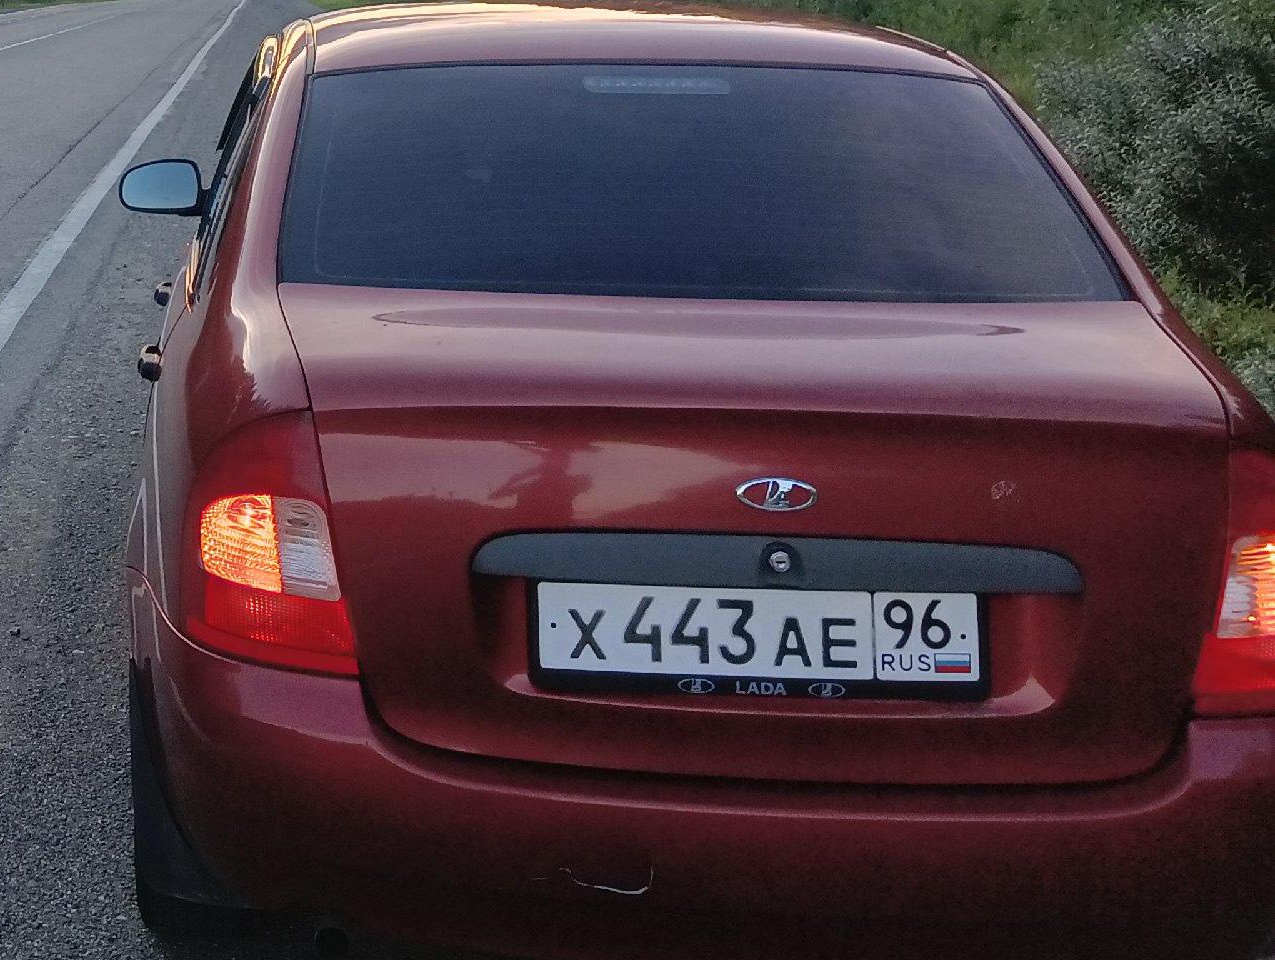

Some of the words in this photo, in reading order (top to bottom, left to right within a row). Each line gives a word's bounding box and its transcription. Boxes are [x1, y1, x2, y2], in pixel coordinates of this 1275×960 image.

[882, 599, 951, 649] 96
[882, 654, 931, 672] RUS
[735, 680, 787, 696] LADA
